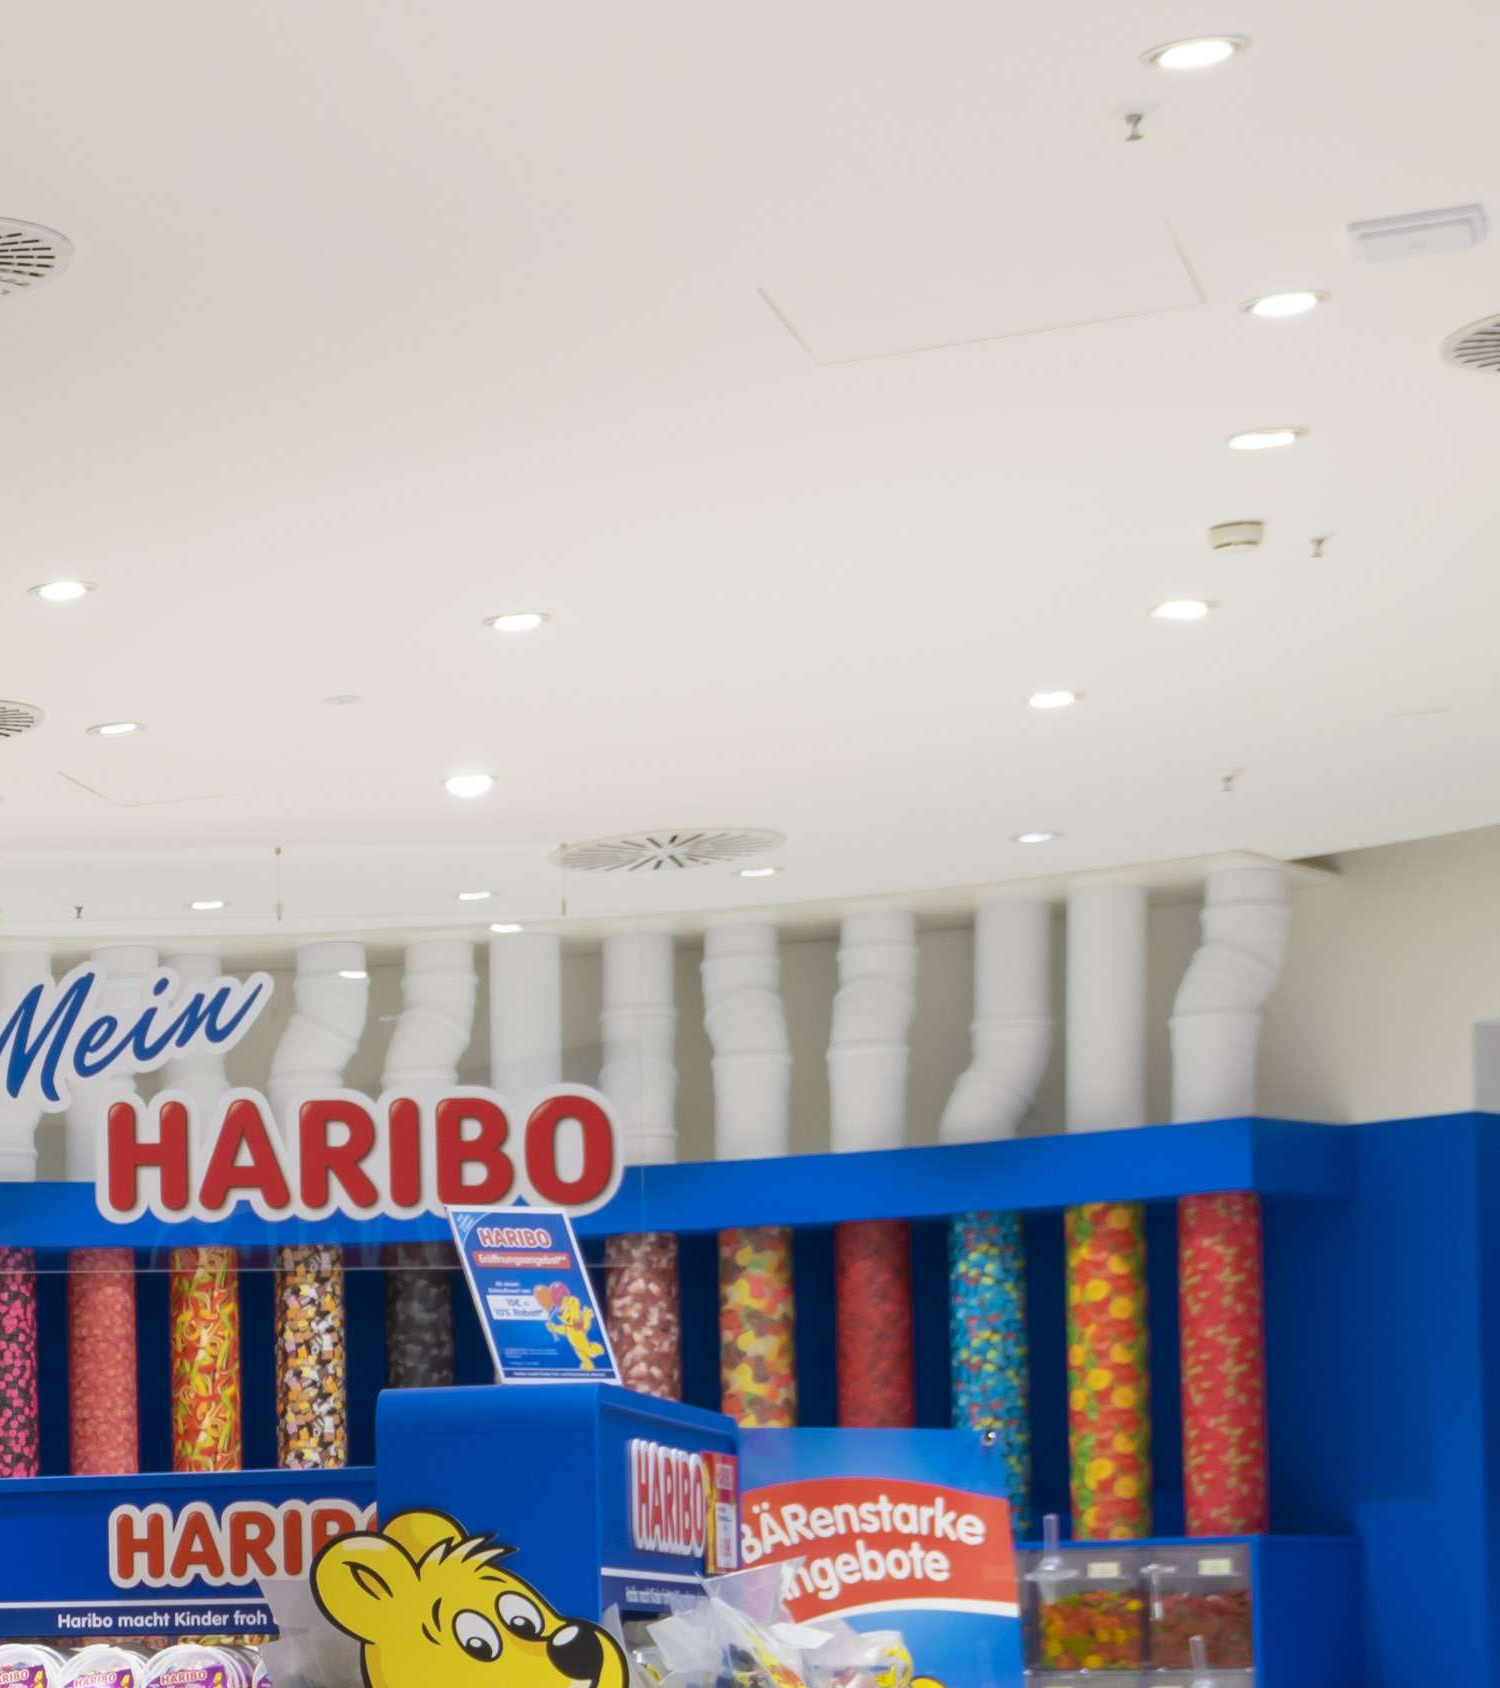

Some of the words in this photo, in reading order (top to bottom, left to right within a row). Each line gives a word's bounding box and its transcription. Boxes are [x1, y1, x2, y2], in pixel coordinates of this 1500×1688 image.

[104, 1092, 616, 1212] HARIBO
[478, 1228, 551, 1248] HARIBO
[634, 1440, 706, 1554] HARIBO
[116, 1506, 378, 1580] HARI
[740, 1500, 987, 1564] BÄRenstarke
[57, 1613, 113, 1630] Haribo
[119, 1612, 170, 1629] macht
[174, 1610, 230, 1627] Kinder
[233, 1609, 268, 1626] froh
